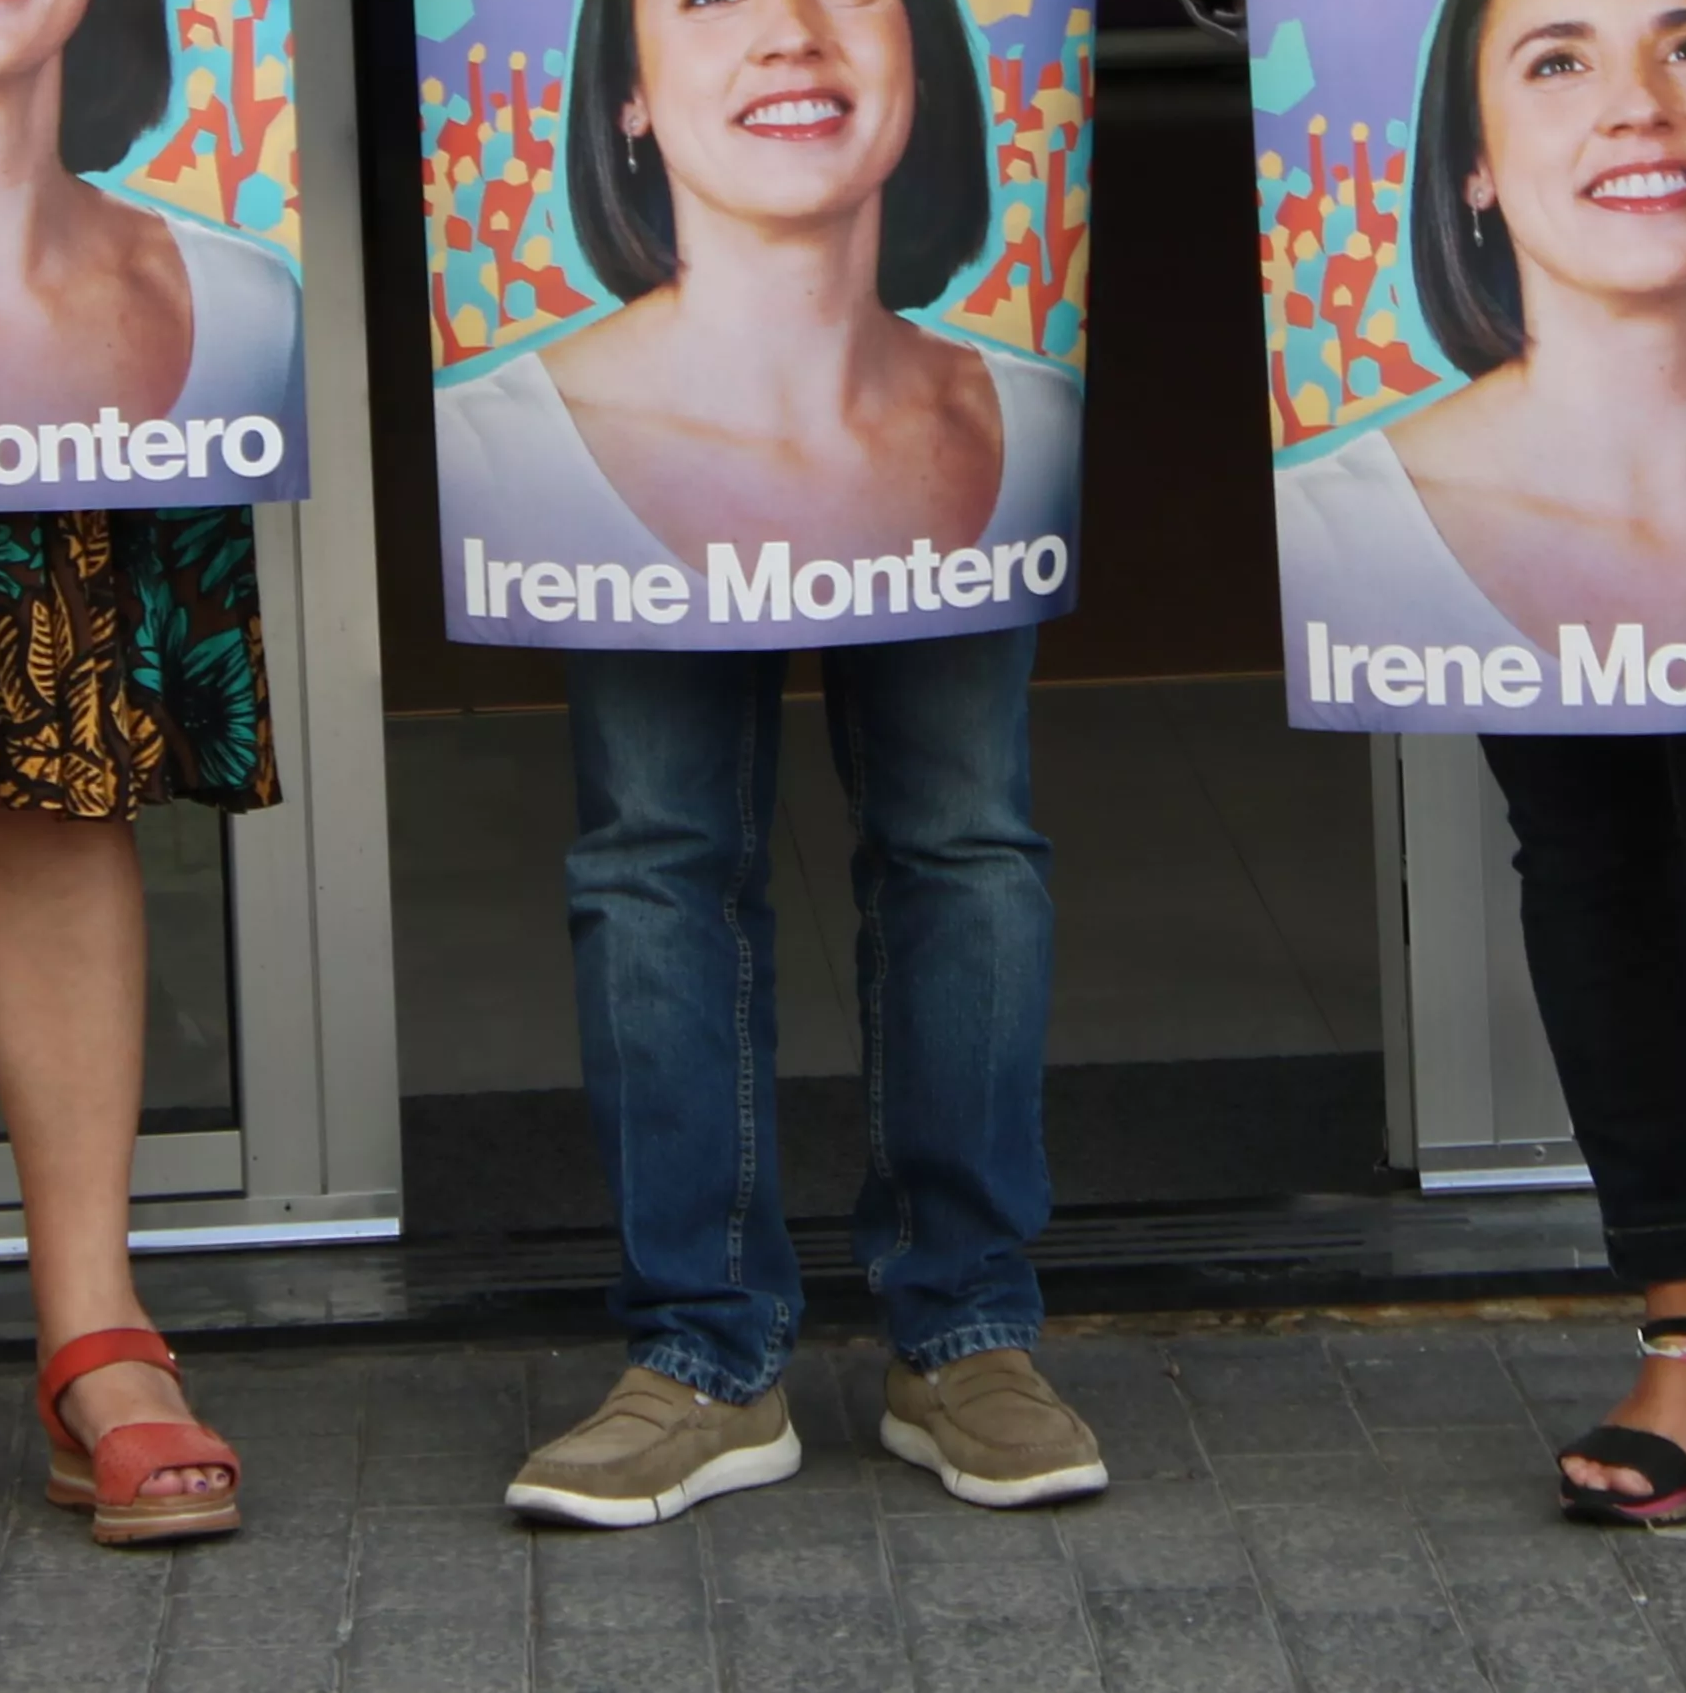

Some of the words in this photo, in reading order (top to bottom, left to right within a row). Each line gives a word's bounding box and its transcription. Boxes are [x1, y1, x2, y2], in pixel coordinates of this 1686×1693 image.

[463, 537, 690, 625] Irene
[707, 534, 1068, 623] Montero
[1306, 621, 1543, 708] Irene
